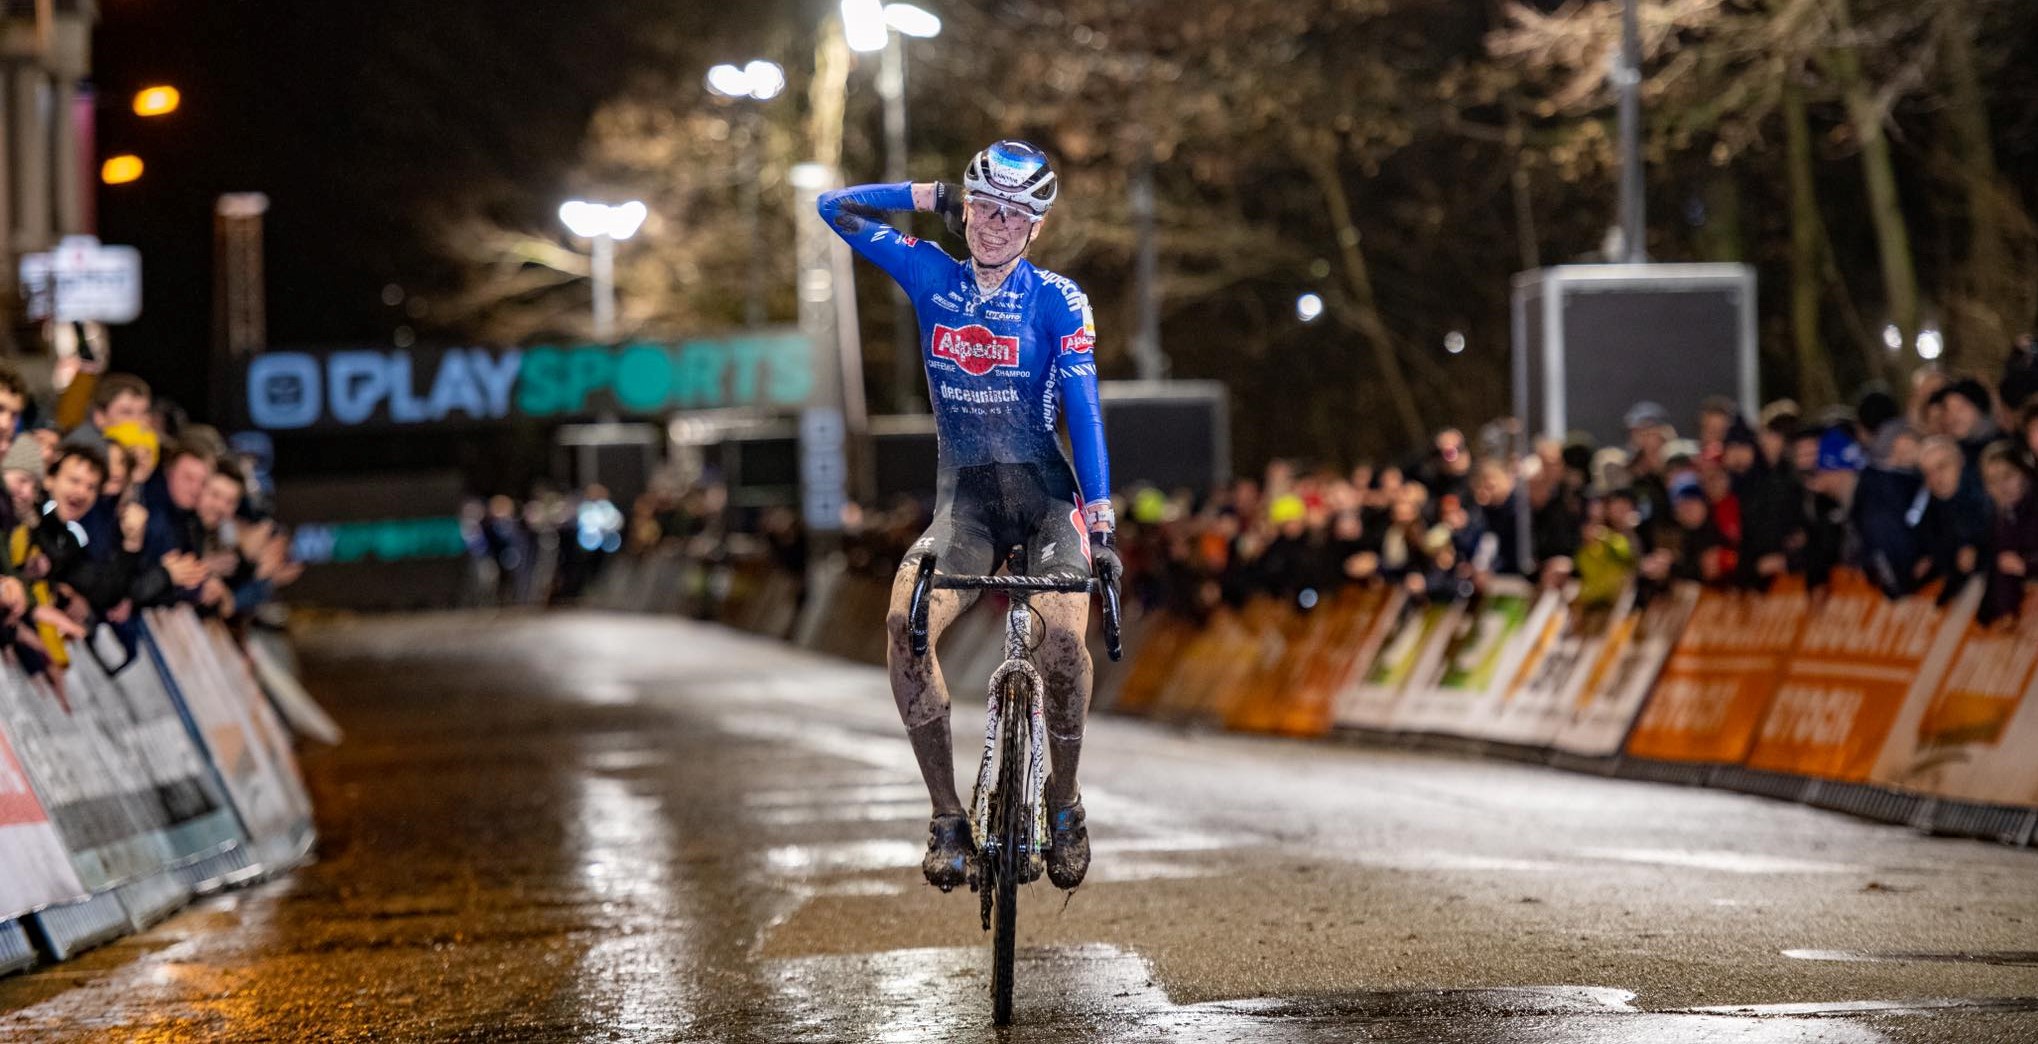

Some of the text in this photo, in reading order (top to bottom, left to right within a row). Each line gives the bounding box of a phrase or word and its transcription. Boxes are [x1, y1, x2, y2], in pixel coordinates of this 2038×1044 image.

[1033, 269, 1084, 313] Alpecin
[938, 332, 1010, 362] Alpecin
[994, 369, 1031, 378] SHAMPOO
[940, 381, 1020, 404] deceuninck
[1761, 683, 1865, 744] STOCK
